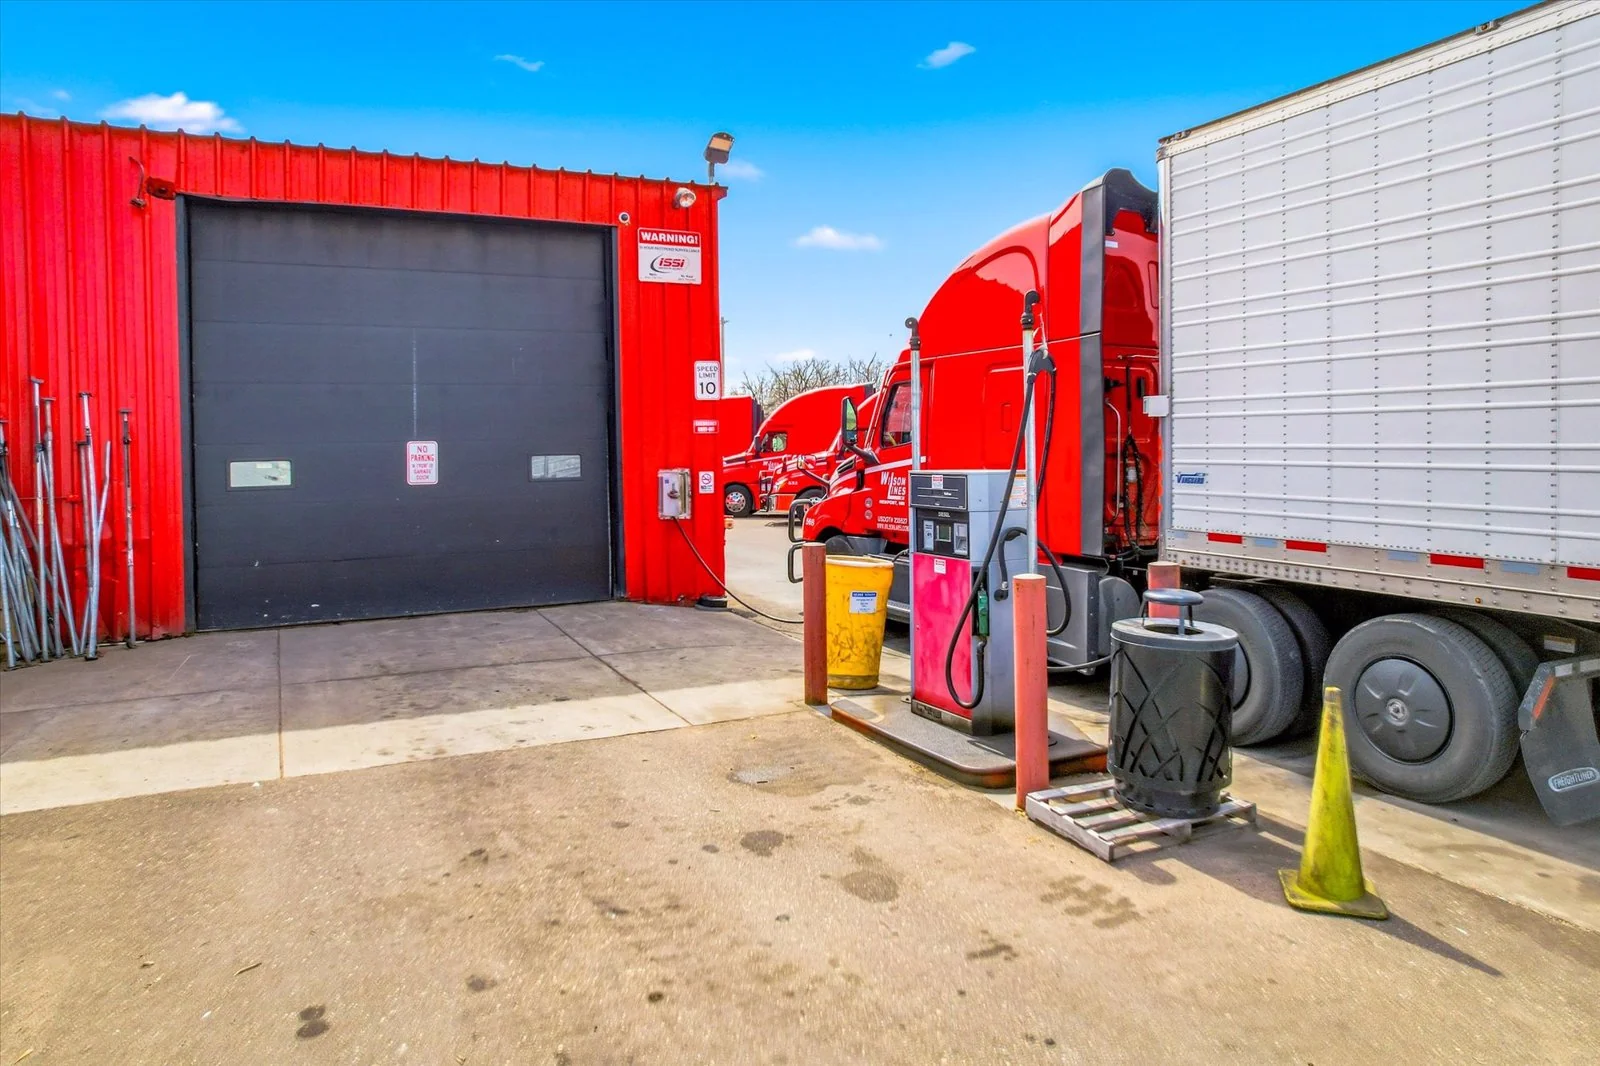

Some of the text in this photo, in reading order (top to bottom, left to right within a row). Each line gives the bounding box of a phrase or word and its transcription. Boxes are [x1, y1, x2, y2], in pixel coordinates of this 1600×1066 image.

[640, 231, 698, 245] WARNING!
[700, 382, 716, 395] 10
[417, 445, 428, 453] NO
[880, 471, 907, 486] WILSON
[1553, 770, 1594, 788] FREIGHTLINER
